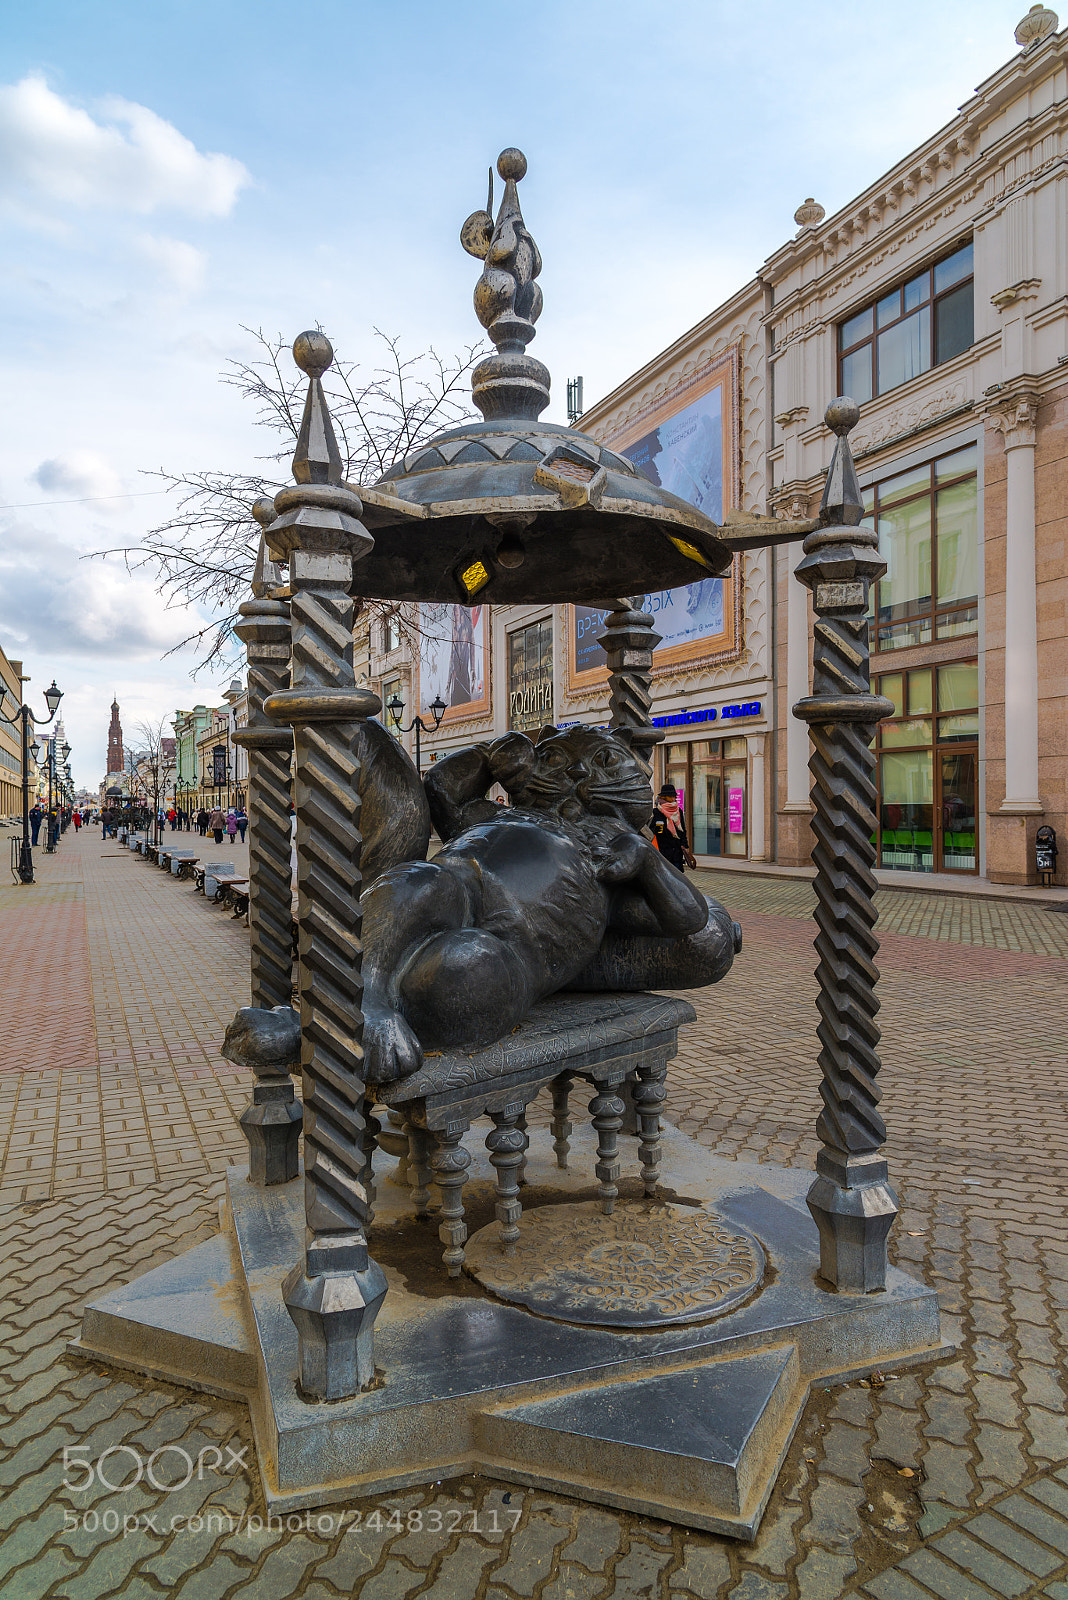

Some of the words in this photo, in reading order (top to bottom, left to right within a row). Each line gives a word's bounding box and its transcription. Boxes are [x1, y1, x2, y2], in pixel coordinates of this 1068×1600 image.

[510, 682, 552, 717] РОДИНА
[651, 708, 717, 728] английского
[721, 701, 762, 720] языка
